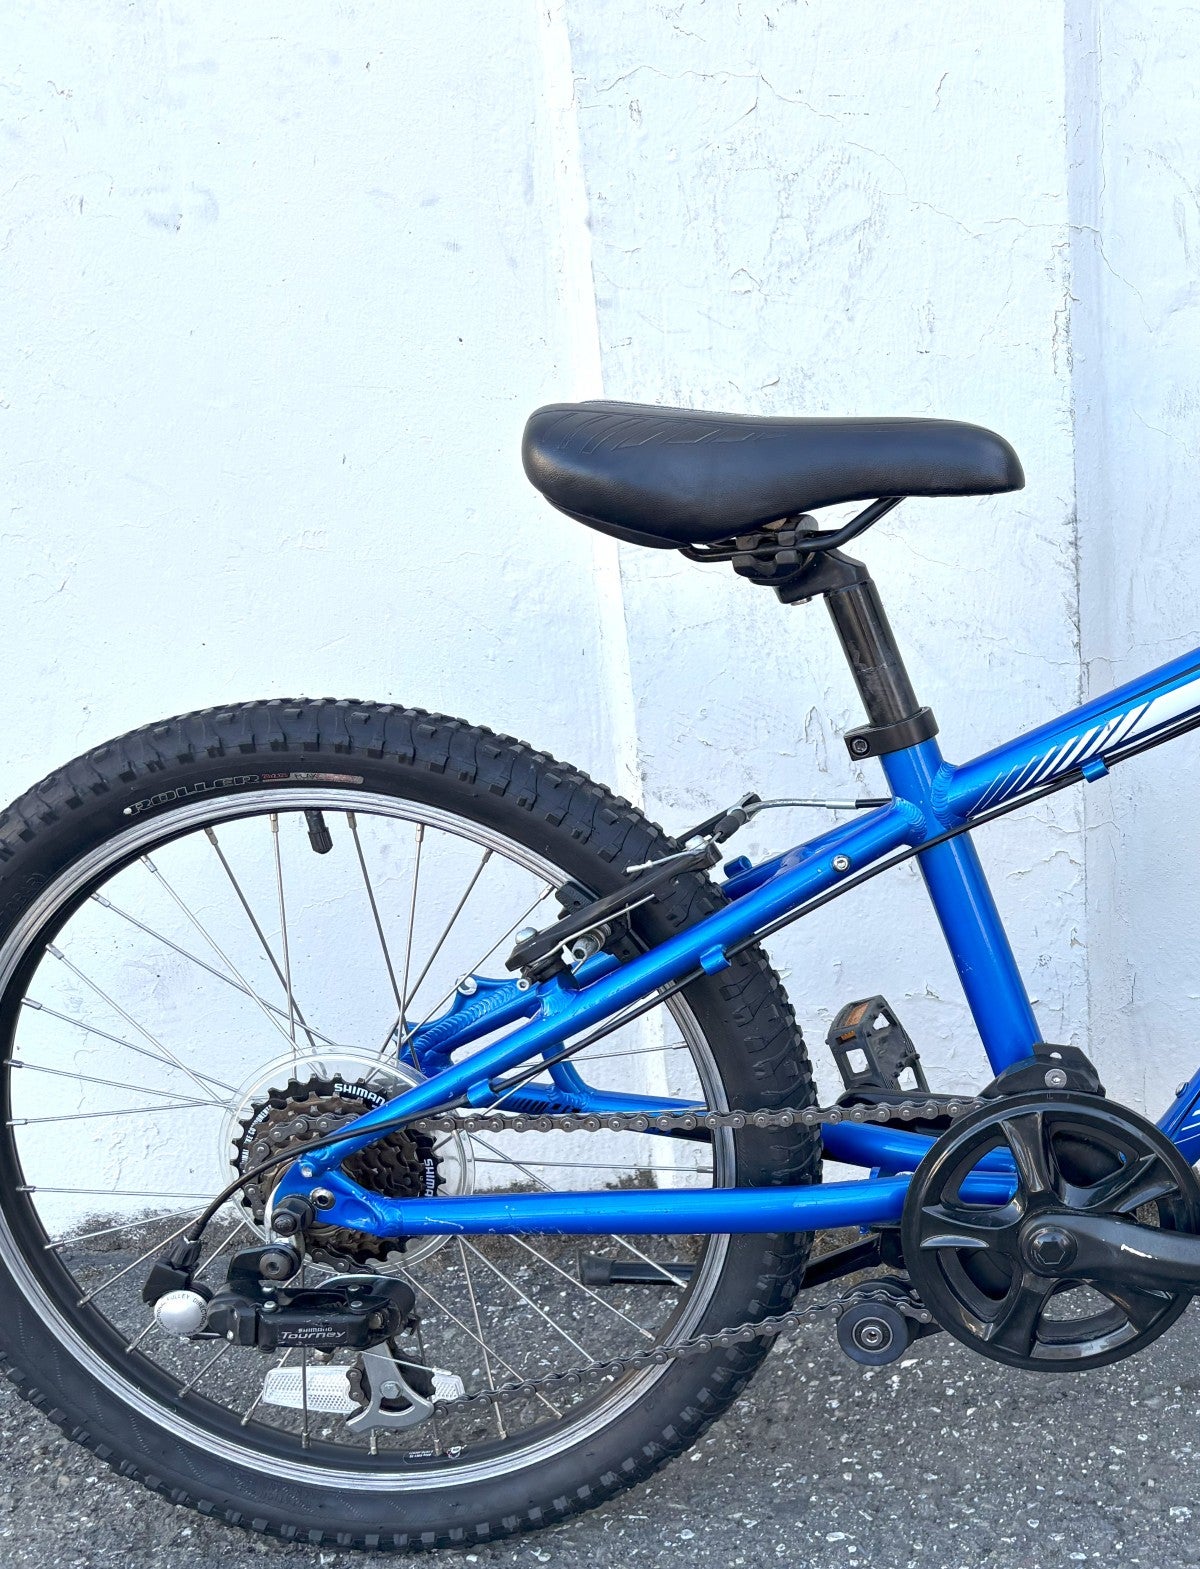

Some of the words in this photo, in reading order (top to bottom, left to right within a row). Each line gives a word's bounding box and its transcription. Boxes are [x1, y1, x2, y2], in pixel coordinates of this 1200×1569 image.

[131, 774, 260, 816] ROLLER
[334, 1083, 386, 1106] SHIMAN
[424, 1158, 435, 1197] SHIMA
[281, 1331, 346, 1340] Tourney
